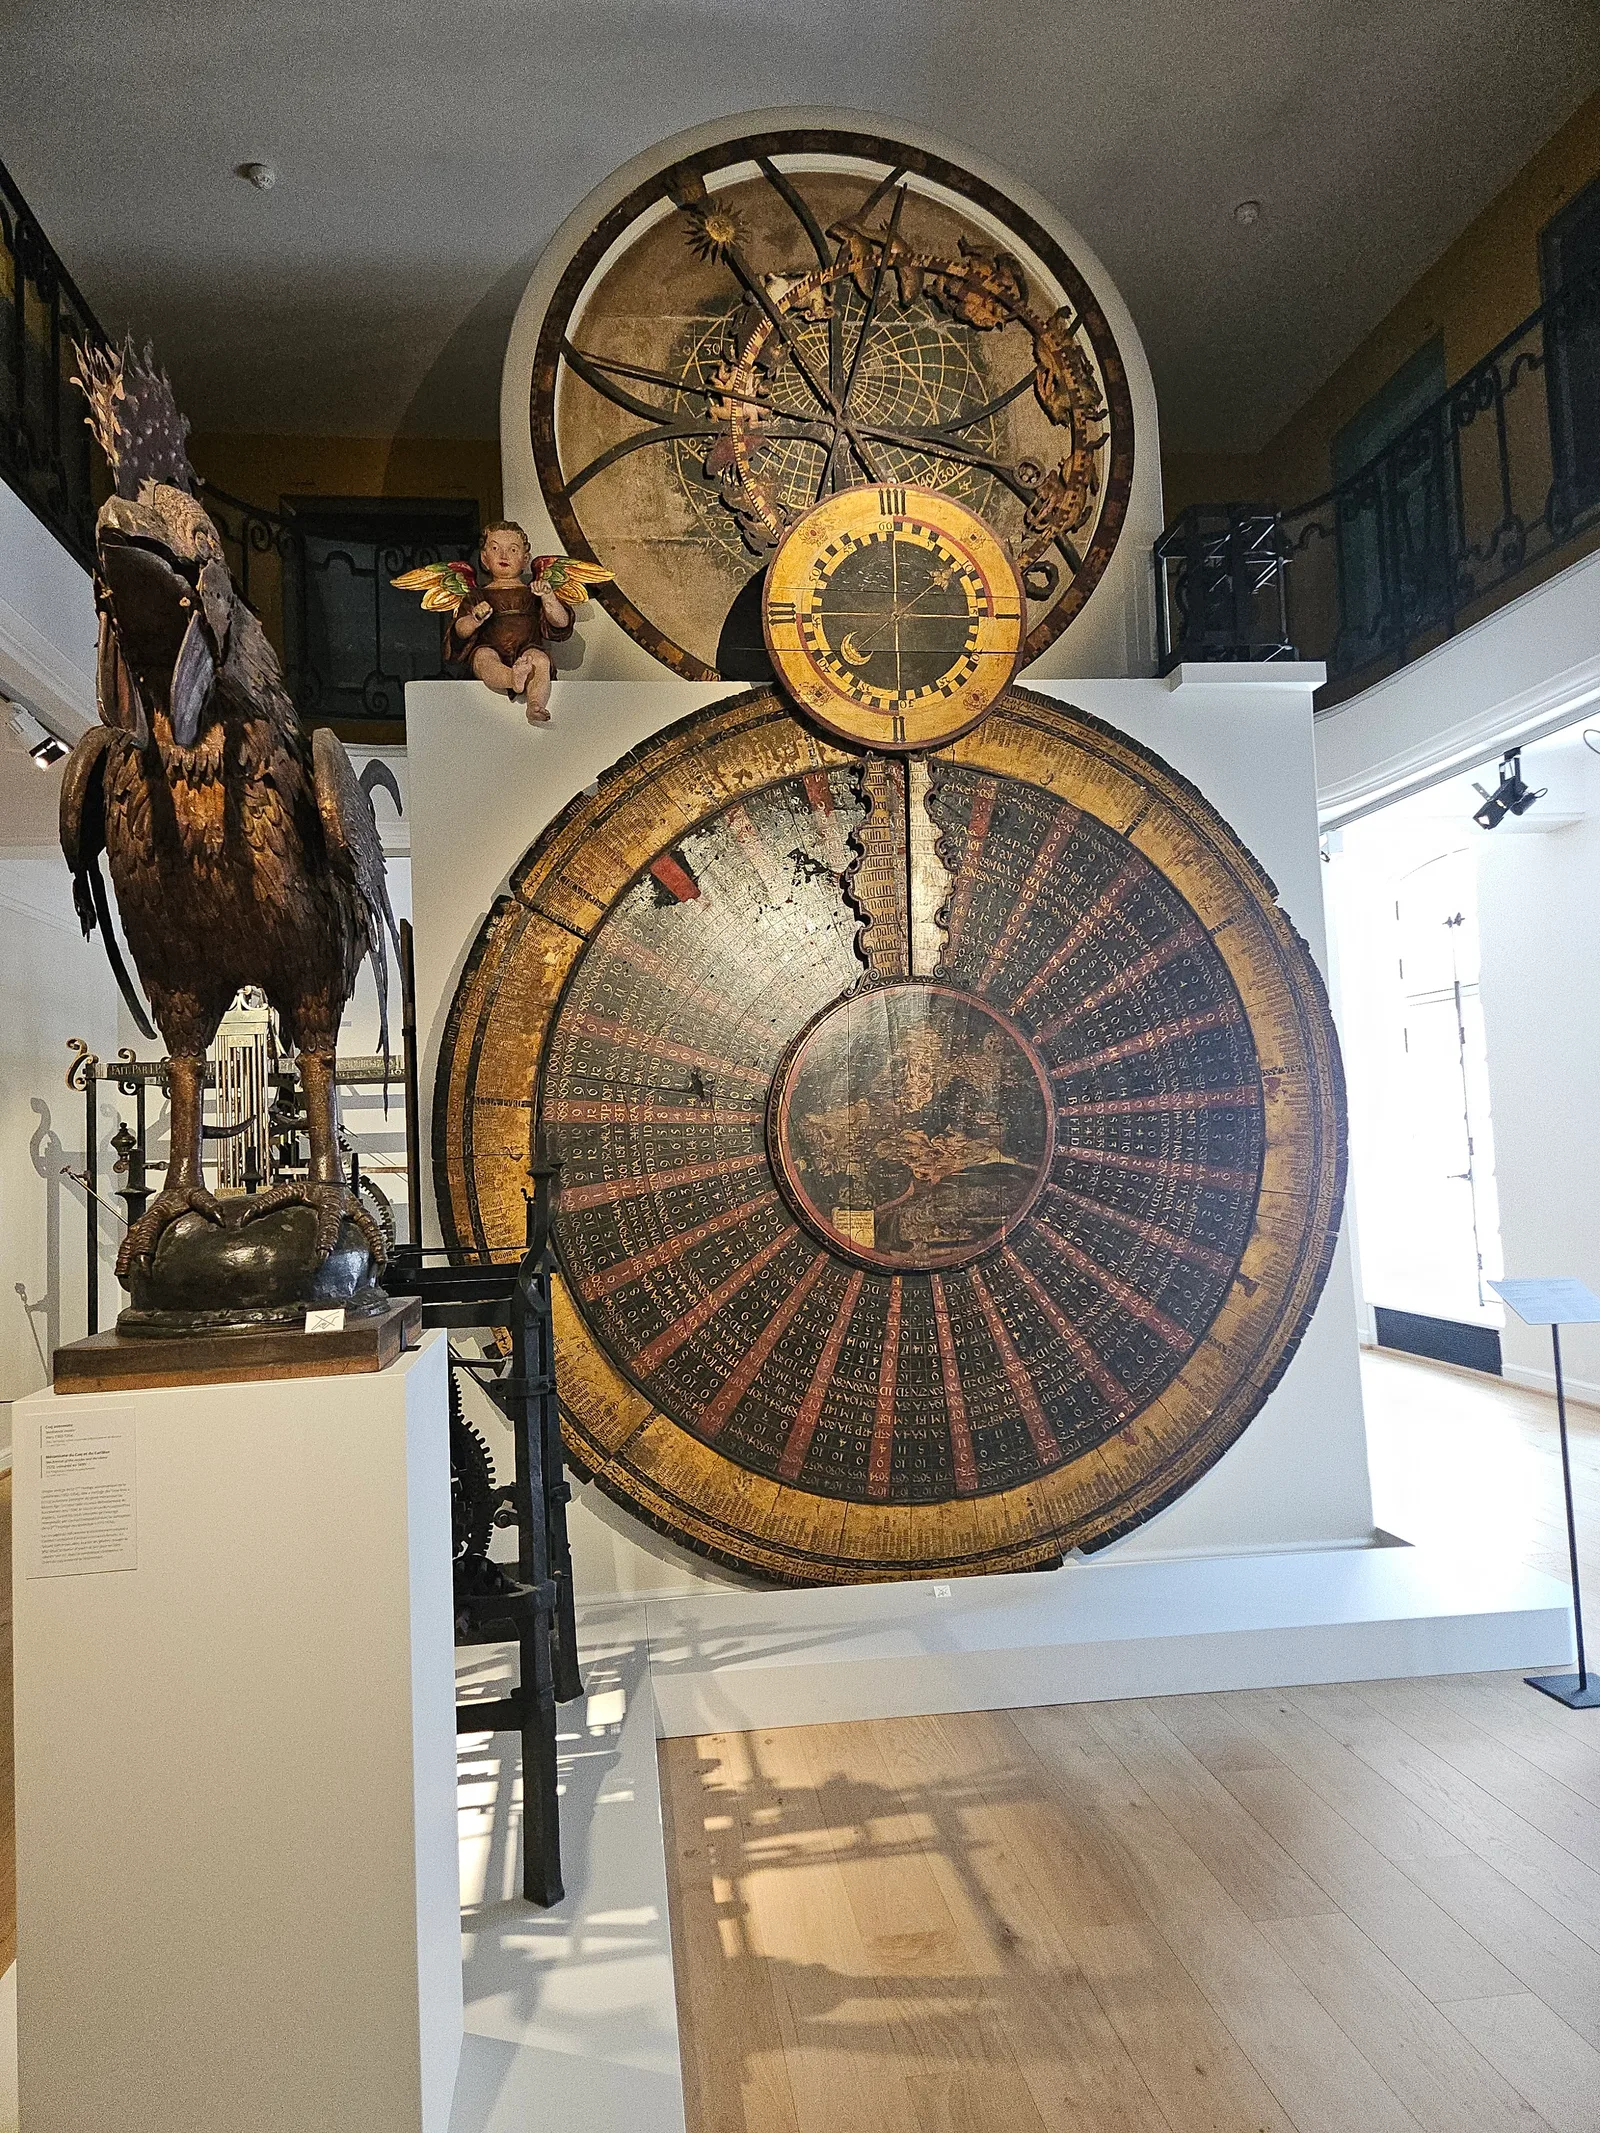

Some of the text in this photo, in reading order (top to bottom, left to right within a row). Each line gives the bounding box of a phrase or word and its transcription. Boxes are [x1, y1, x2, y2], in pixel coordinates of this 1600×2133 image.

[768, 601, 797, 626] III
[582, 1211, 594, 1225] 10
[614, 1290, 627, 1303] 10
[666, 1357, 681, 1373] 10
[680, 1372, 696, 1388] 10
